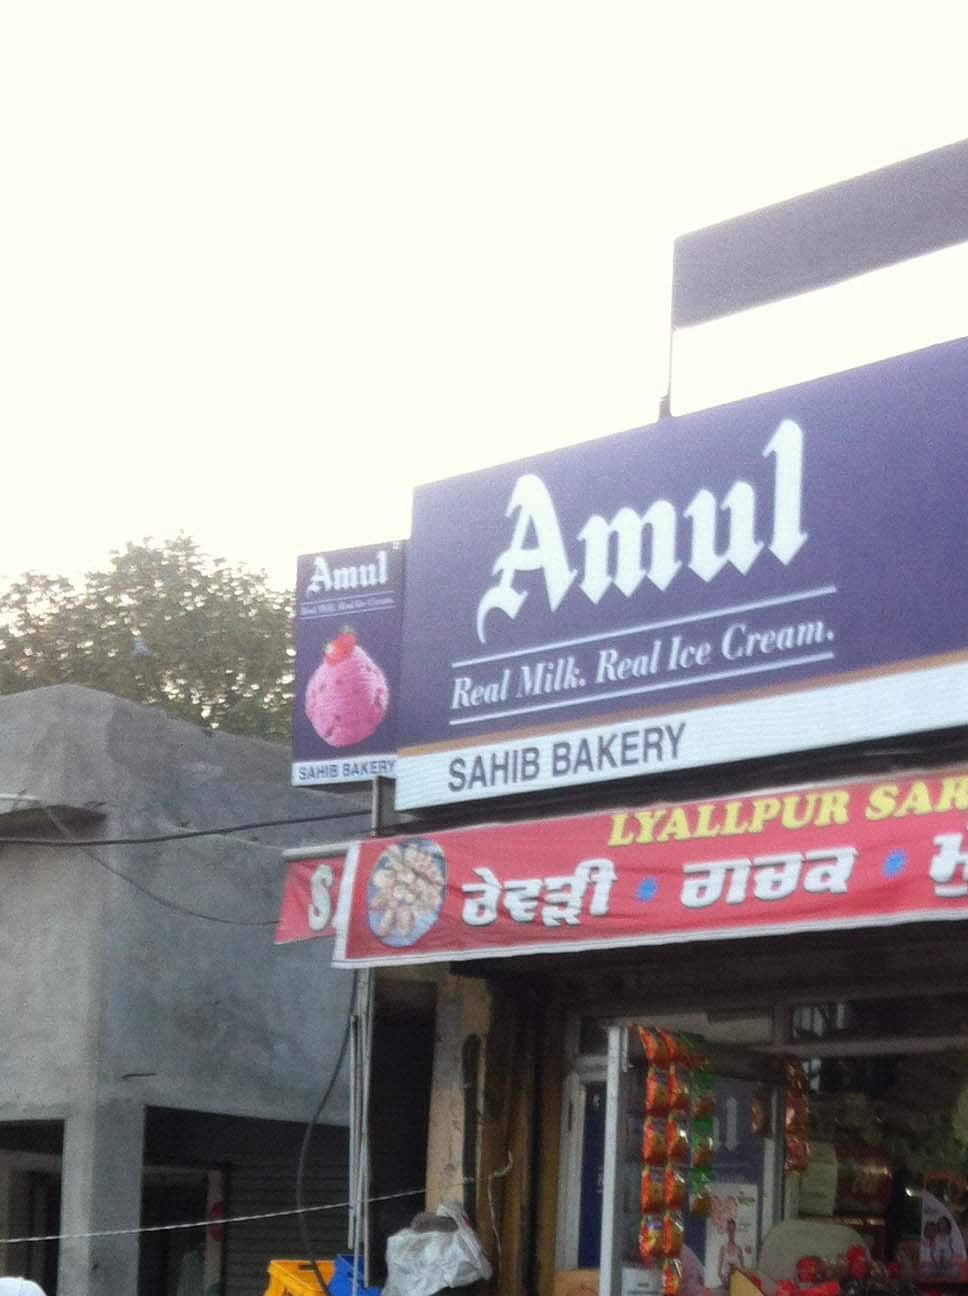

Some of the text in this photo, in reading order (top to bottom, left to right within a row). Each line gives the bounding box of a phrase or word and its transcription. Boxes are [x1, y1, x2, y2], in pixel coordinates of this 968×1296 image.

[475, 417, 809, 644] Amul
[306, 550, 388, 598] Amul
[450, 620, 835, 710] Real Milk. Real Ice Cream.
[298, 759, 397, 781] SAHIB BAKERY
[448, 722, 686, 793] SAHIB BAKERY
[607, 788, 850, 847] LYALLPUR
